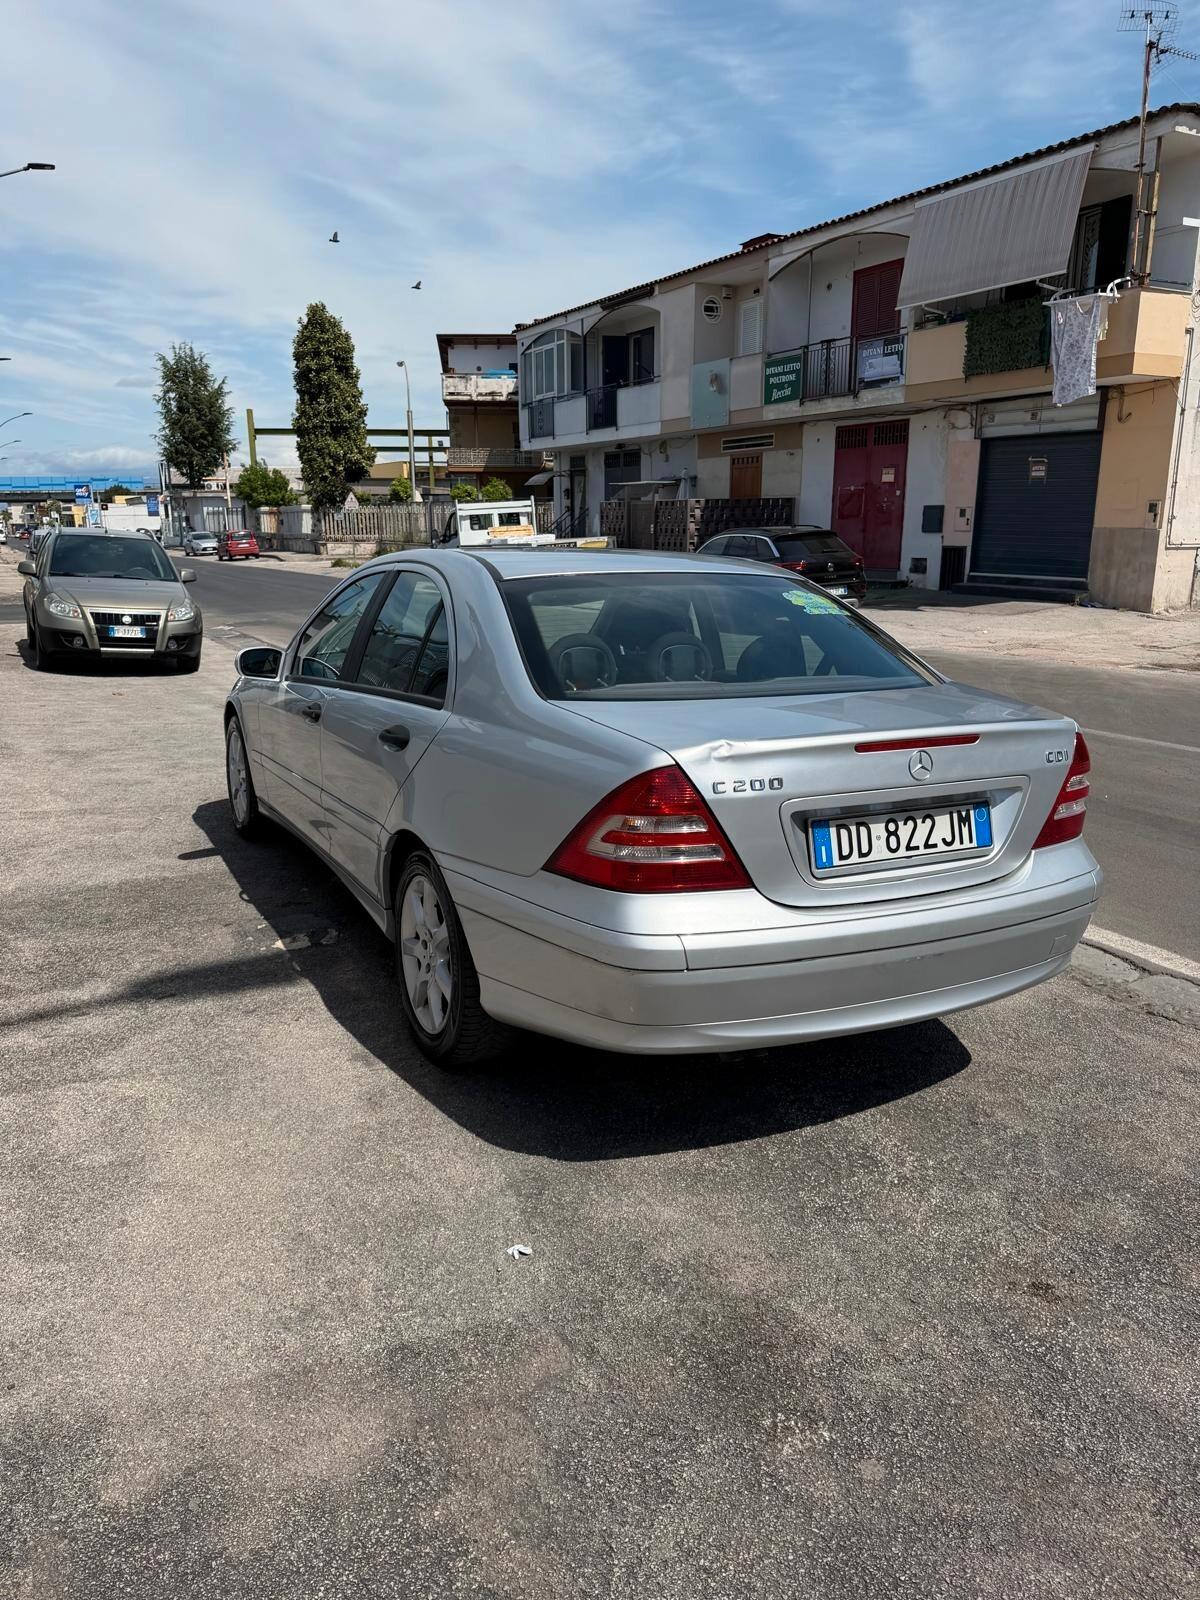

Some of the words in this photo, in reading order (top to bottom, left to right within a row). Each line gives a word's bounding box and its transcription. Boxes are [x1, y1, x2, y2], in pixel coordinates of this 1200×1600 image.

[862, 346, 883, 358] DIVANI
[884, 343, 904, 354] LETTO
[766, 366, 784, 375] DIVANI
[784, 362, 801, 372] LETTO
[769, 373, 796, 384] POLTRONE
[1045, 749, 1069, 763] CDI
[712, 781, 727, 795] C
[733, 777, 784, 793] 200
[835, 821, 873, 861] DD
[884, 813, 938, 854] 822
[941, 808, 974, 848] JM
